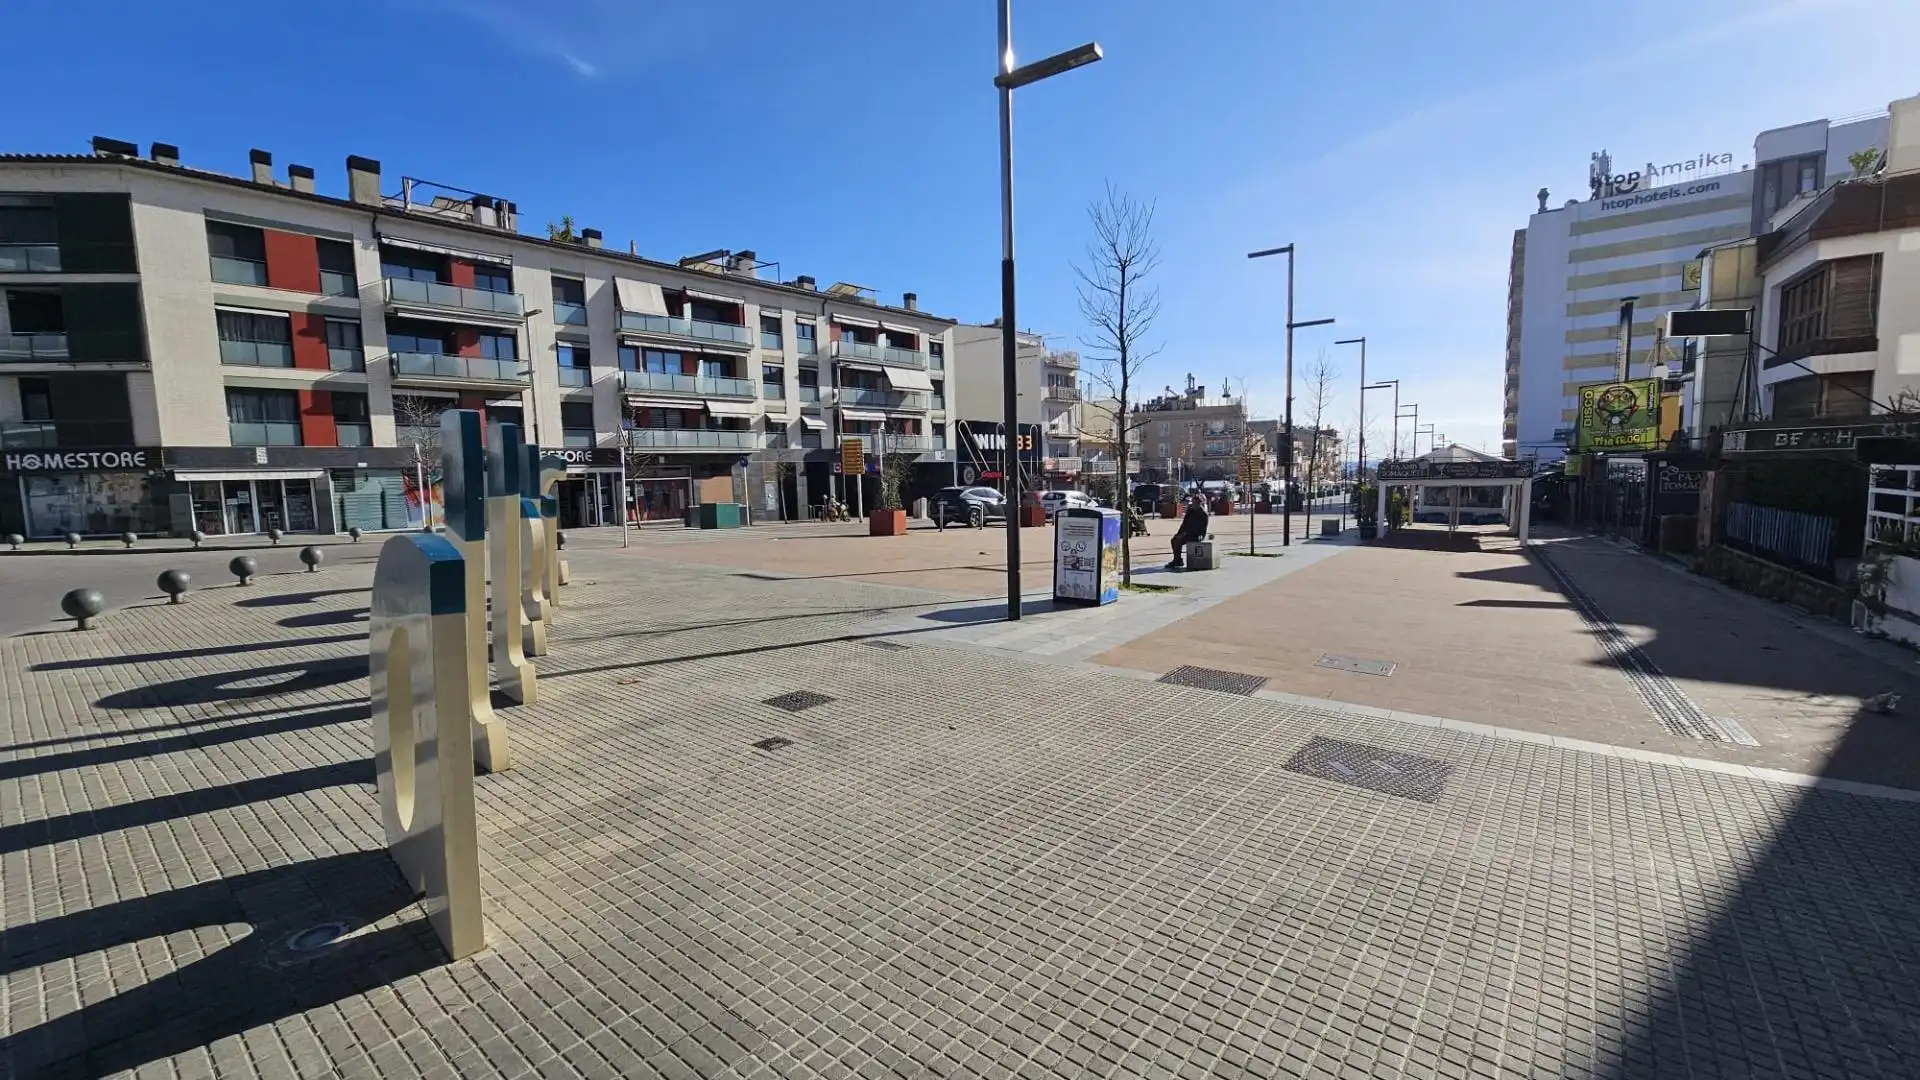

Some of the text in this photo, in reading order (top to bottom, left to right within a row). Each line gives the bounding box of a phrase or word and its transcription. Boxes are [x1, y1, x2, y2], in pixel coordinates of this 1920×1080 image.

[1645, 152, 1733, 178] Amaika
[1601, 181, 1720, 210] htophotels.com
[1584, 390, 1594, 427] DISCO
[5, 451, 147, 471] HOMESTORE
